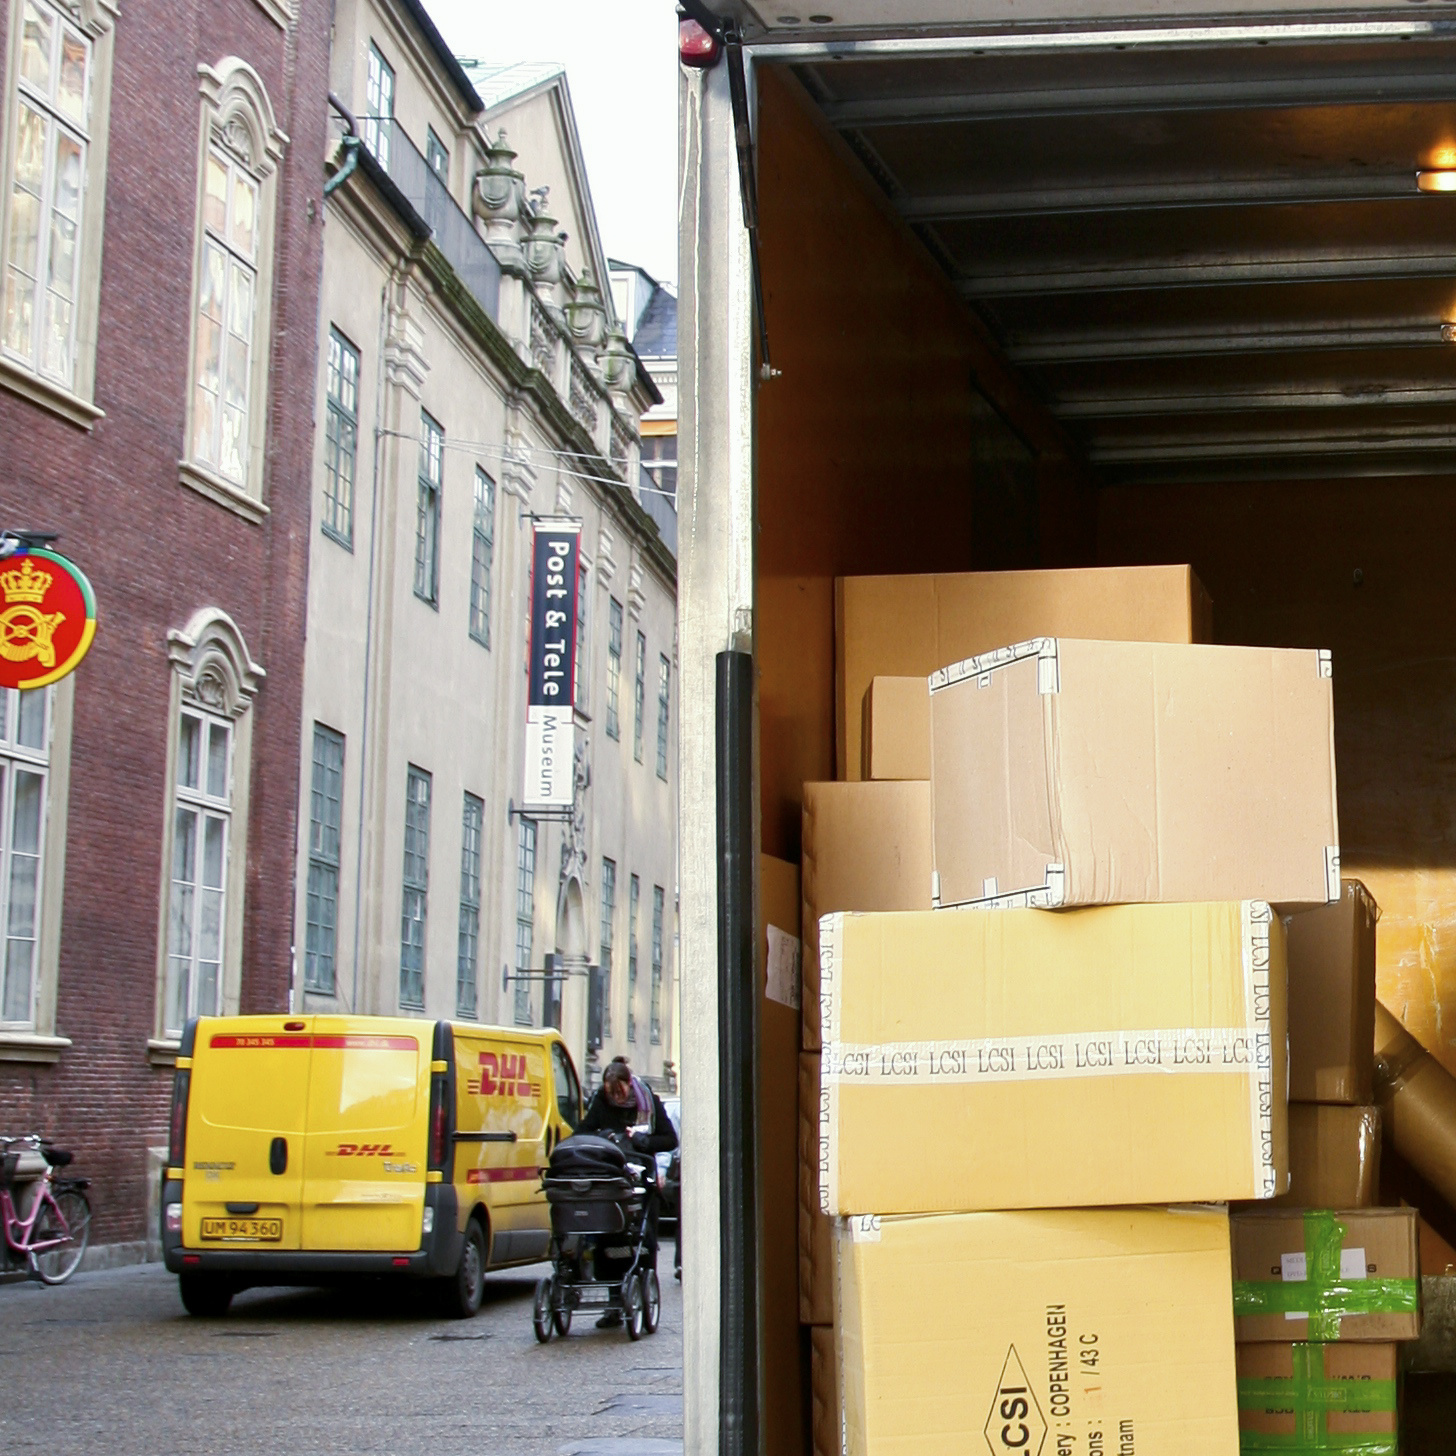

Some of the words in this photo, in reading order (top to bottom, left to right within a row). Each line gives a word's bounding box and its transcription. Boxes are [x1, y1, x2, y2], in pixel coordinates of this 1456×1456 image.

[547, 541, 570, 598] Post
[545, 610, 567, 628] &
[543, 639, 565, 696] Tele
[540, 715, 557, 797] Museum
[479, 1052, 532, 1096] DHL
[880, 1051, 919, 1076] LCSI
[929, 1049, 967, 1075] LCSI
[978, 1046, 1016, 1073] LCSI
[1026, 1044, 1065, 1070] LCSI
[1075, 1041, 1113, 1068] LCSI
[1124, 1039, 1163, 1065] LCSI
[1173, 1038, 1212, 1064] LCSI
[337, 1144, 395, 1156] DHL
[205, 1221, 226, 1235] UM
[231, 1221, 248, 1235] 94
[250, 1221, 279, 1236] 360
[1046, 1304, 1070, 1417] COPENHAGEN
